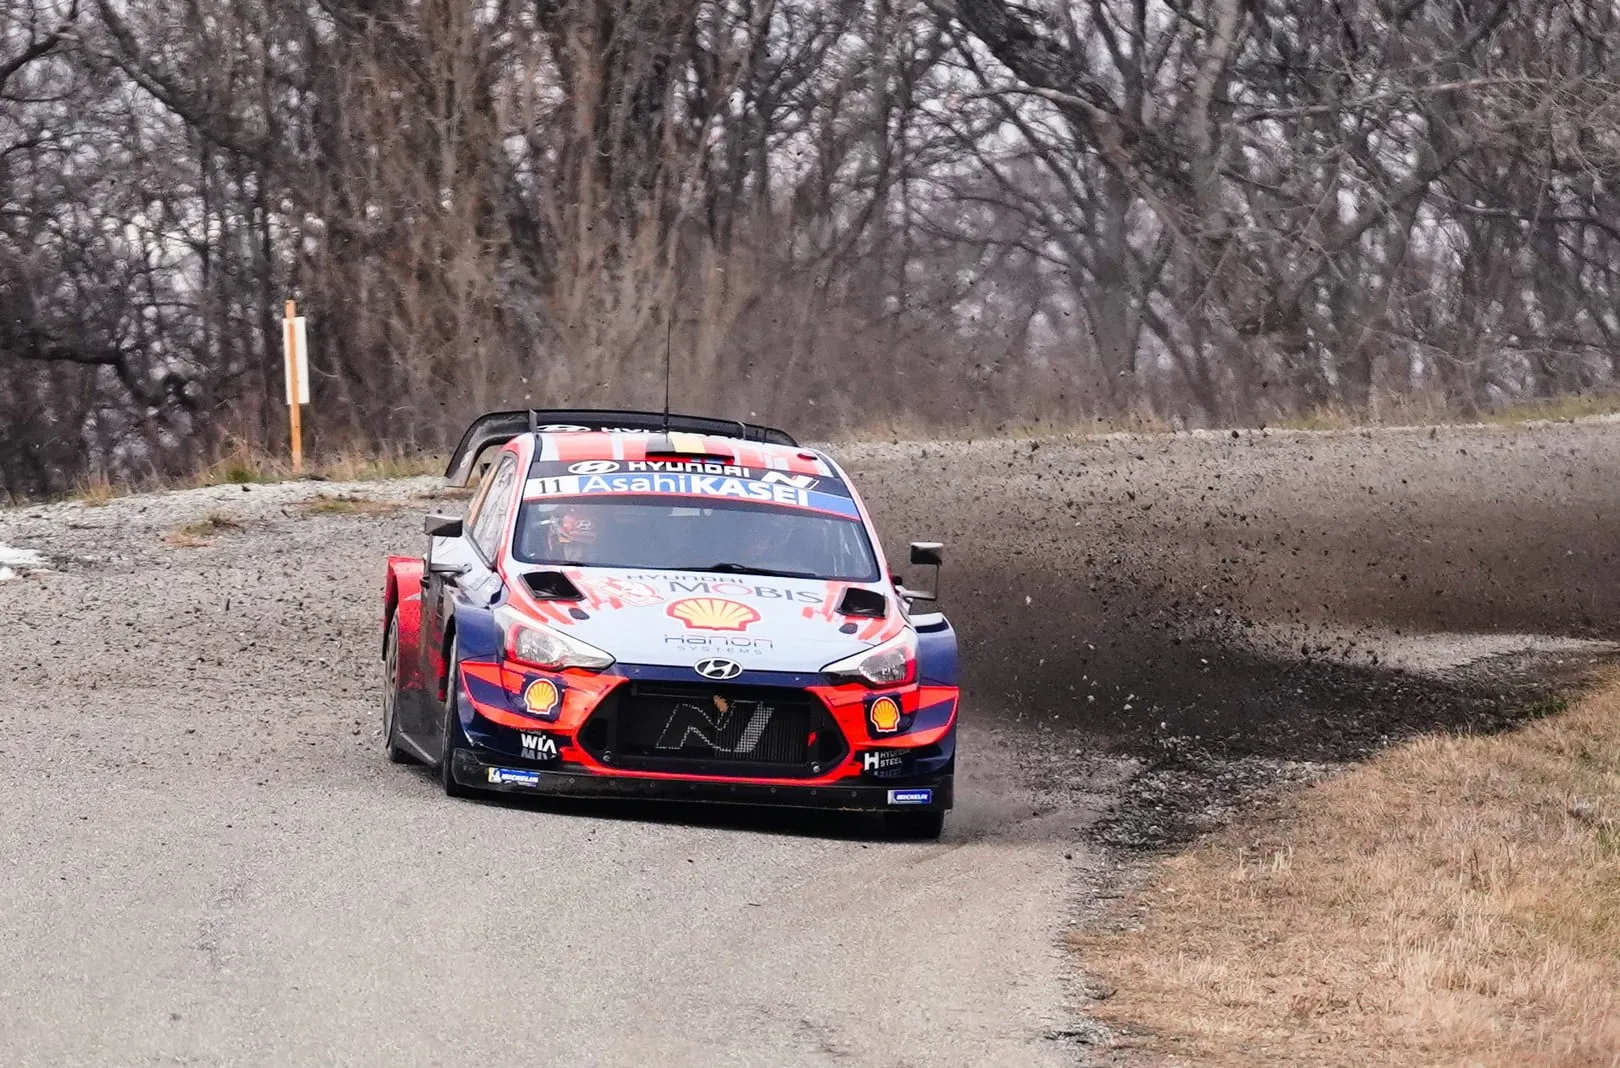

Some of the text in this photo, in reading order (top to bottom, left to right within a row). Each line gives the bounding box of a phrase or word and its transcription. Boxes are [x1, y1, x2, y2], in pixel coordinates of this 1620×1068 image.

[628, 461, 750, 477] HYUNDAI
[538, 479, 563, 494] 11
[627, 575, 744, 584] HYUNDAI
[668, 581, 823, 604] MOBIS
[677, 646, 762, 655] SYSTEMS
[880, 757, 903, 768] STEEL
